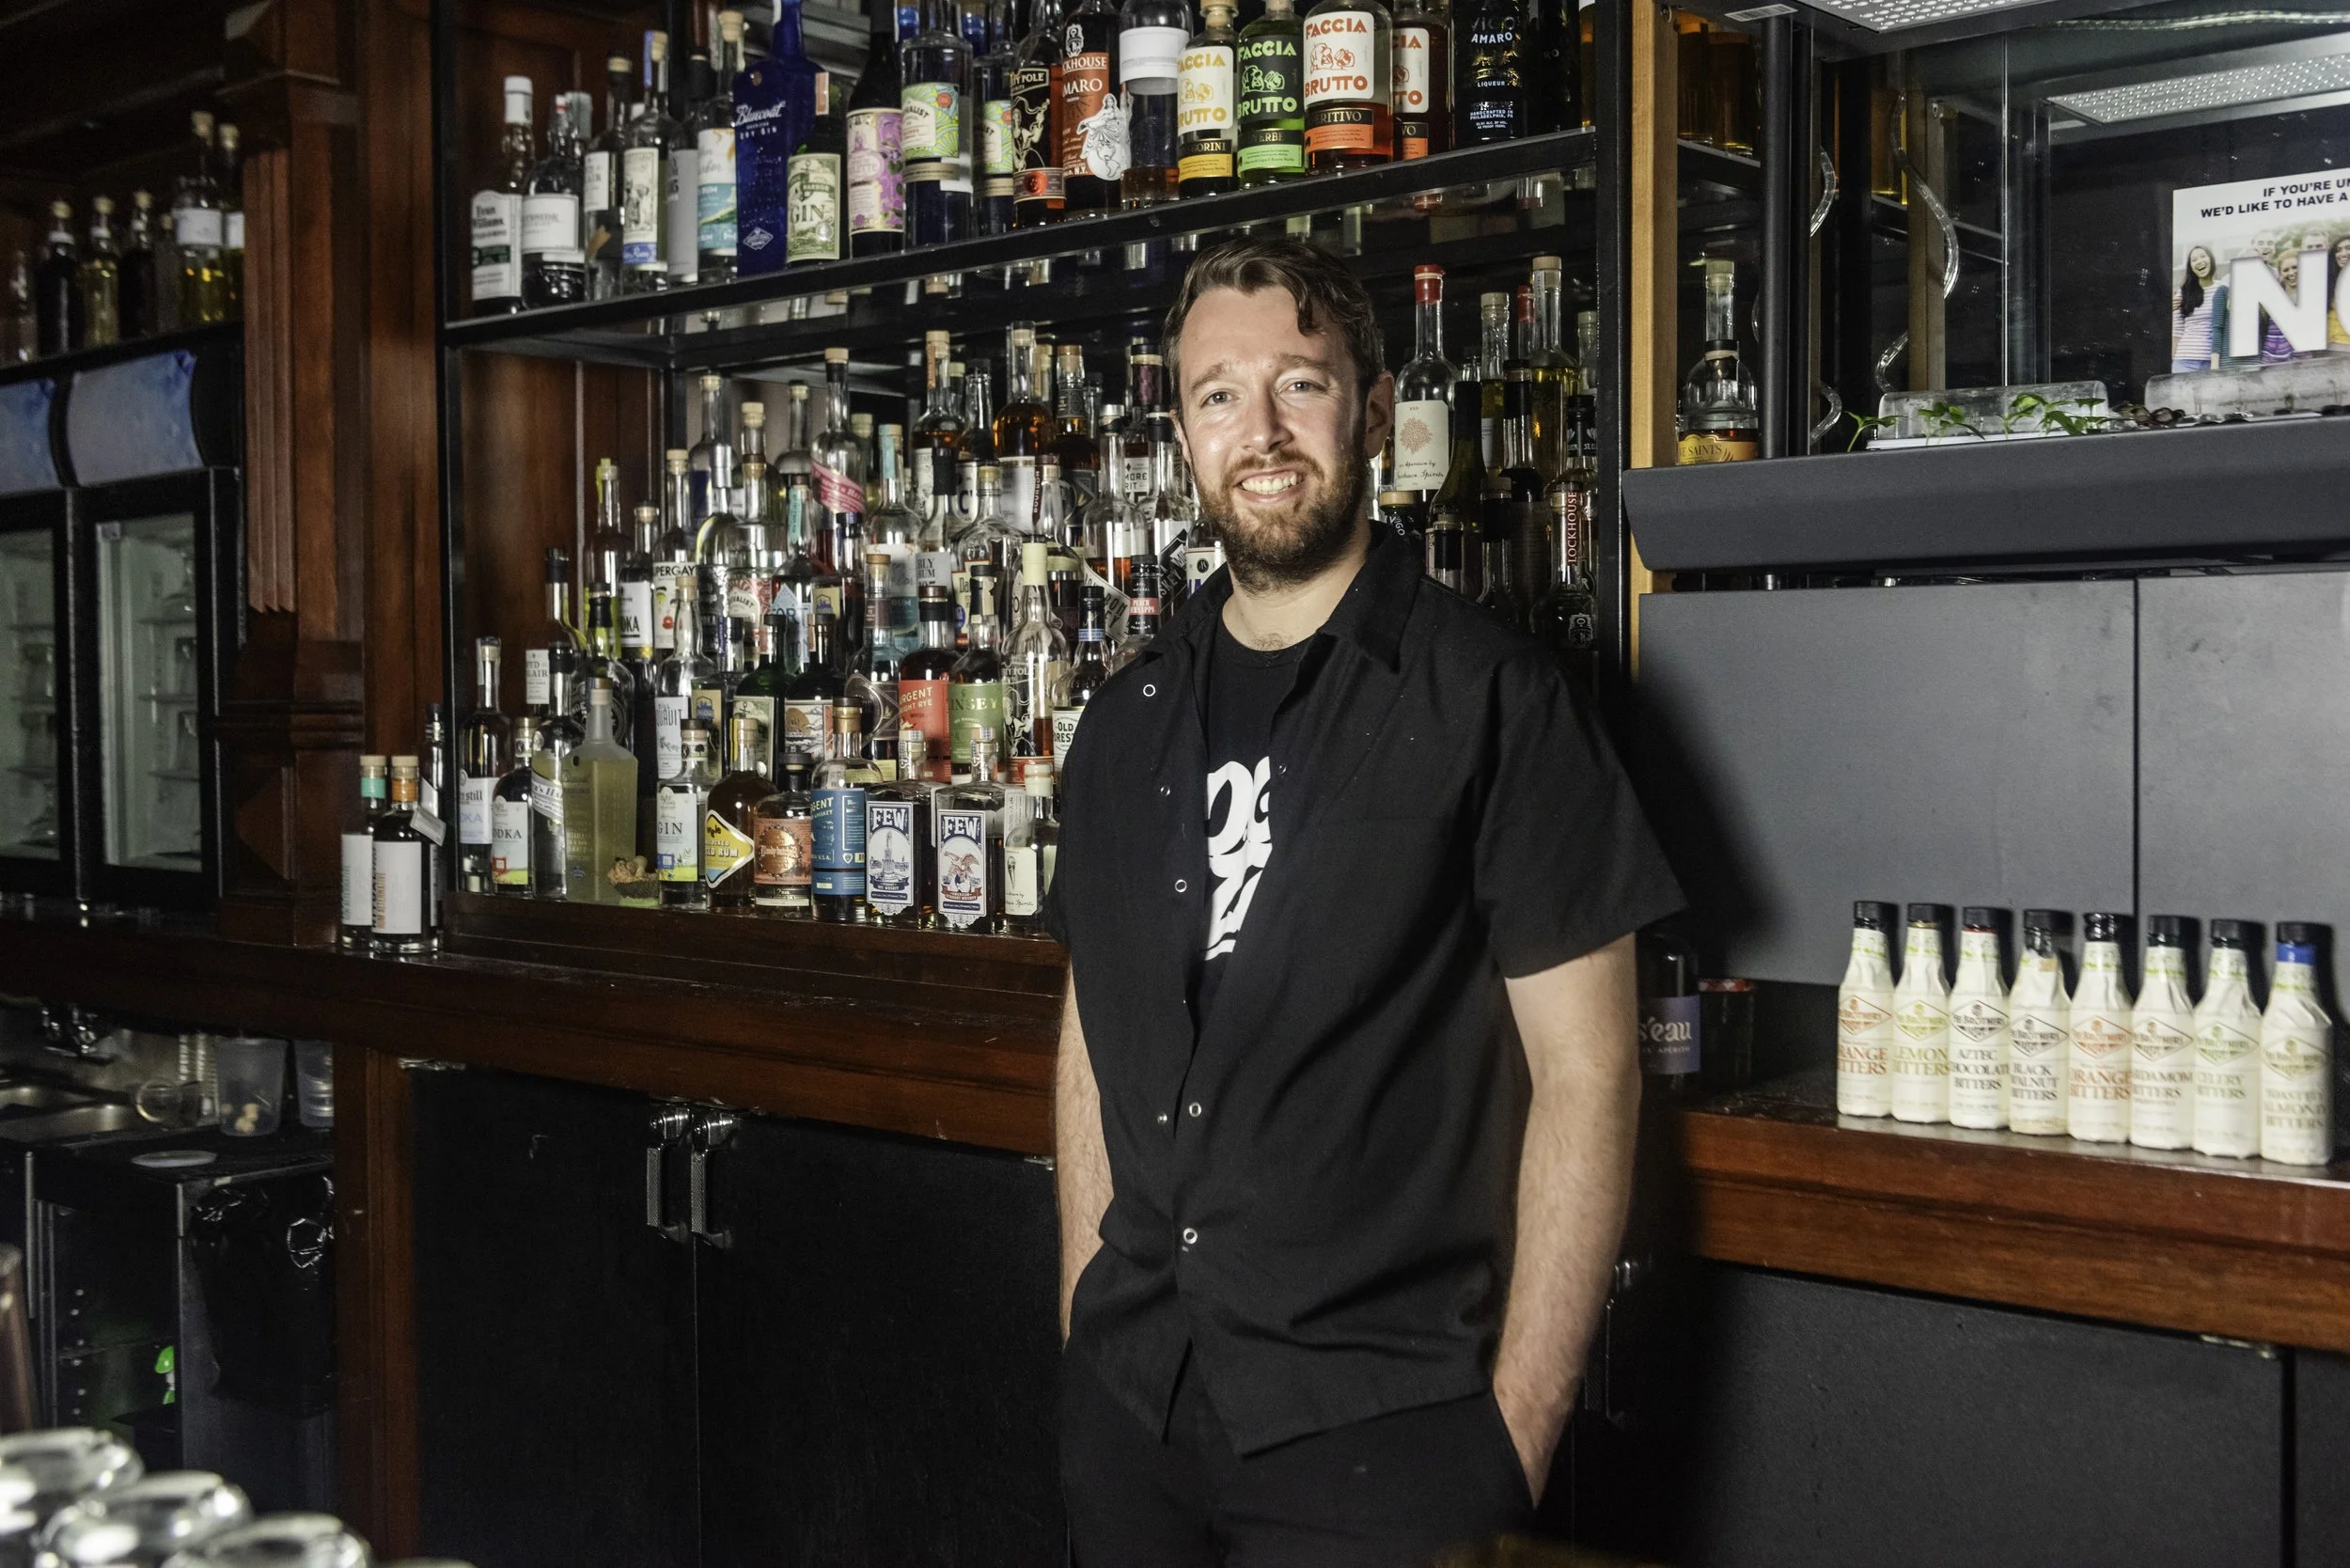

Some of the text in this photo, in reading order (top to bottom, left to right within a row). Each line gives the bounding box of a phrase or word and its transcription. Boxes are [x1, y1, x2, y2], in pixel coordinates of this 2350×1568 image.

[1306, 18, 1368, 40] FACCIA
[1471, 32, 1513, 44] AMARO
[1238, 40, 1297, 61] FACCIA
[1022, 72, 1045, 83] POLE
[1304, 75, 1368, 99] BRUTTO
[1237, 96, 1298, 119] BRUTTO
[2263, 187, 2276, 197] IF
[2280, 180, 2331, 196] YOU'RE
[2201, 192, 2348, 218] WE'D LIKE TO HAVE A
[790, 204, 825, 224] GIN
[1688, 444, 1723, 457] SAINTS
[1032, 470, 1041, 513] BOURBON
[1567, 492, 1577, 563] LOCKHOUSE
[917, 699, 933, 709] RYE
[1058, 721, 1073, 732] OLD
[871, 808, 907, 830] FEW
[943, 816, 979, 839] FEW
[658, 823, 683, 835] GIN
[717, 848, 738, 858] RUM
[1958, 1048, 1998, 1061] AZTEC
[2013, 1062, 2053, 1076] BLACK
[1954, 1077, 2003, 1090] BITTERS
